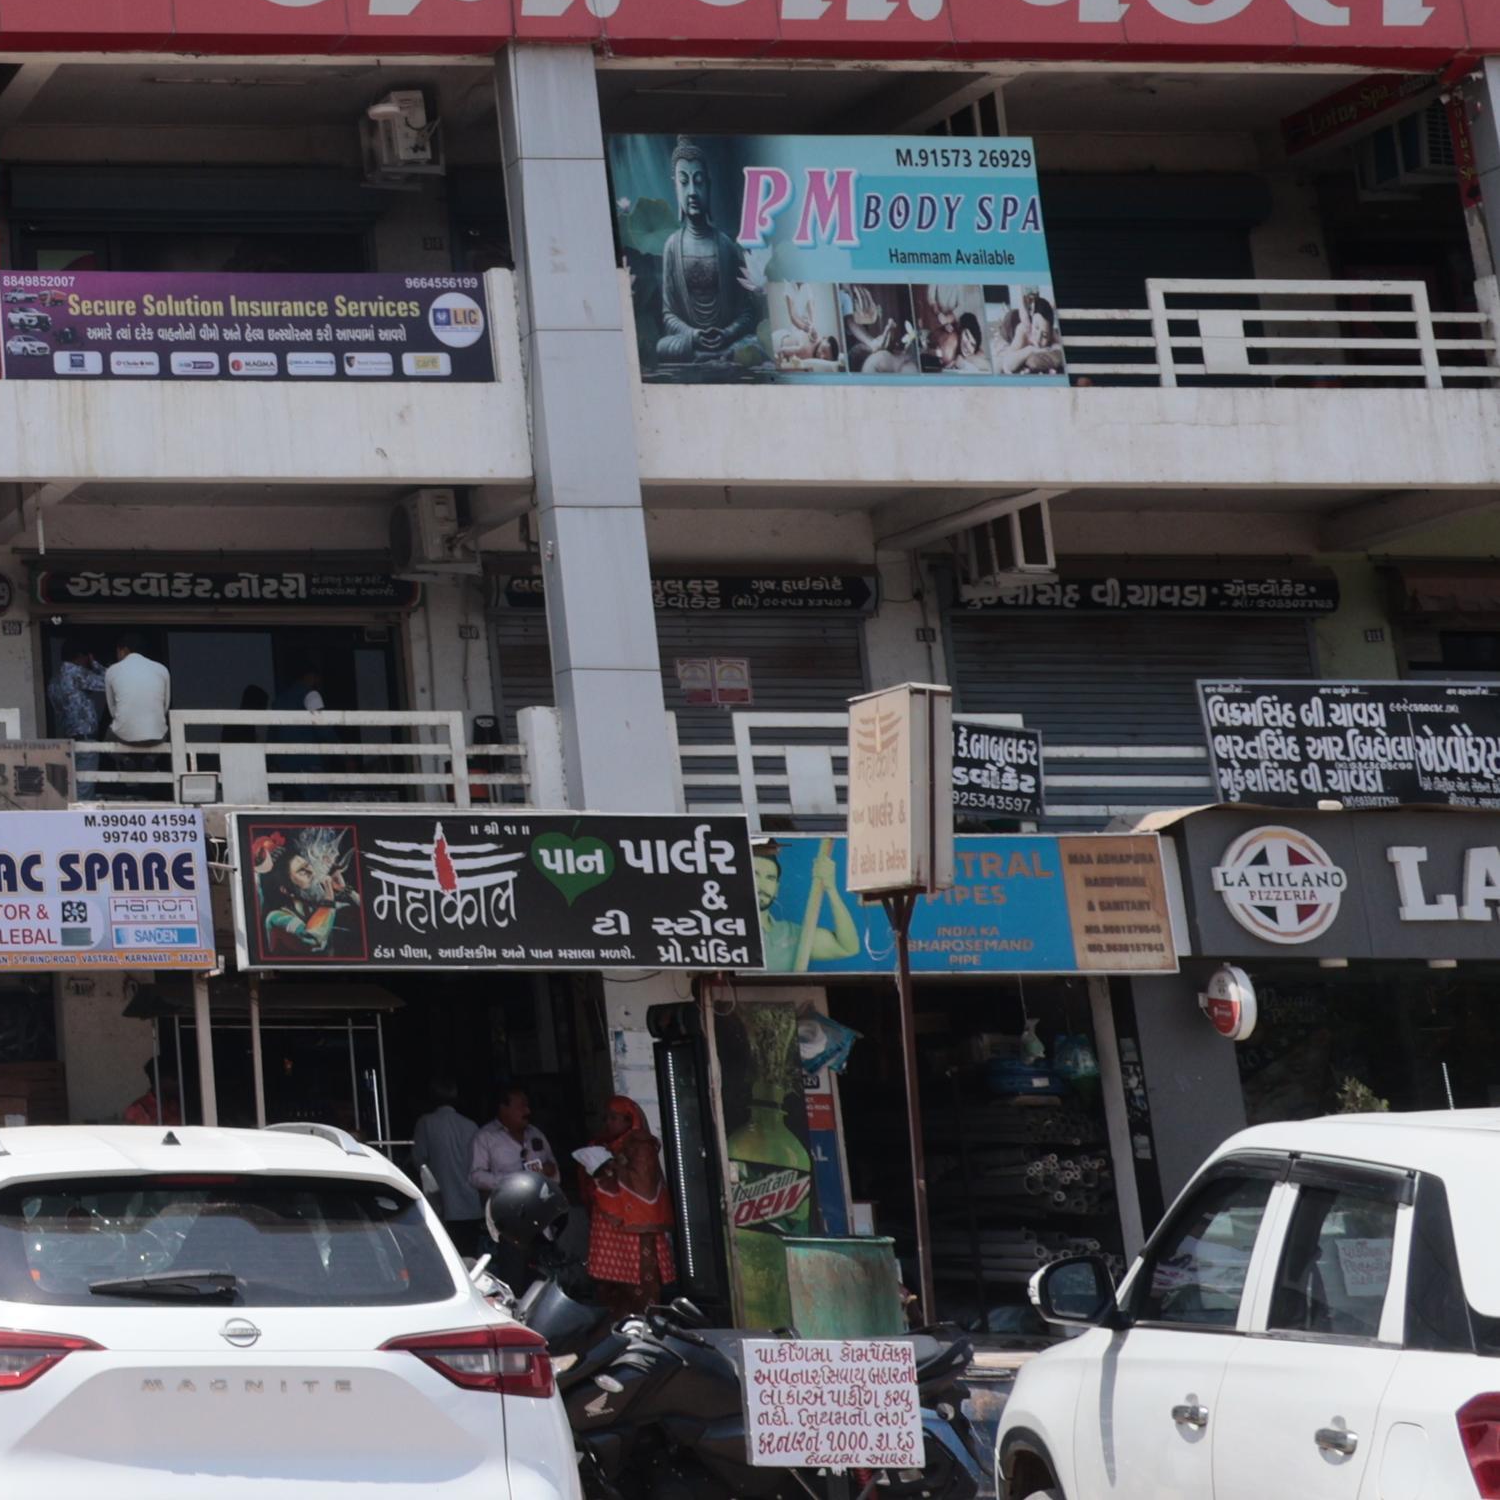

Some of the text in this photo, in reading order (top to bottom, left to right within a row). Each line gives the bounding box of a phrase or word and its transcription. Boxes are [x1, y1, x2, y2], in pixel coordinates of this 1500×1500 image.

[895, 148, 1032, 168] M.91573 26929
[862, 192, 962, 233] BODY
[975, 193, 1043, 234] SPA
[888, 247, 1015, 266] Hammam Available
[3, 275, 75, 288] 8849852007
[404, 276, 478, 289] 9664556199
[68, 293, 421, 318] Secure Solution Insurance Services
[452, 309, 478, 325] LIC
[84, 814, 197, 828] M.99040 41594
[102, 830, 198, 844] 99740 98379
[538, 823, 737, 876] પાન પાર્લર
[58, 851, 196, 893] SPARE
[953, 851, 1053, 878] TRAL
[1221, 871, 1344, 888] LA MILANO
[701, 880, 727, 911] &
[1249, 890, 1318, 902] PIZZERIA
[35, 903, 50, 921] &
[591, 907, 747, 937] ટી સ્ટોલ
[134, 926, 179, 943] SANDEN
[936, 925, 1000, 937] INDIA KA
[502, 945, 526, 960] અને
[530, 948, 554, 959] પાન
[558, 948, 596, 960] મસાલા
[949, 955, 981, 966] PIPE
[141, 1377, 354, 1394] MAGNITE
